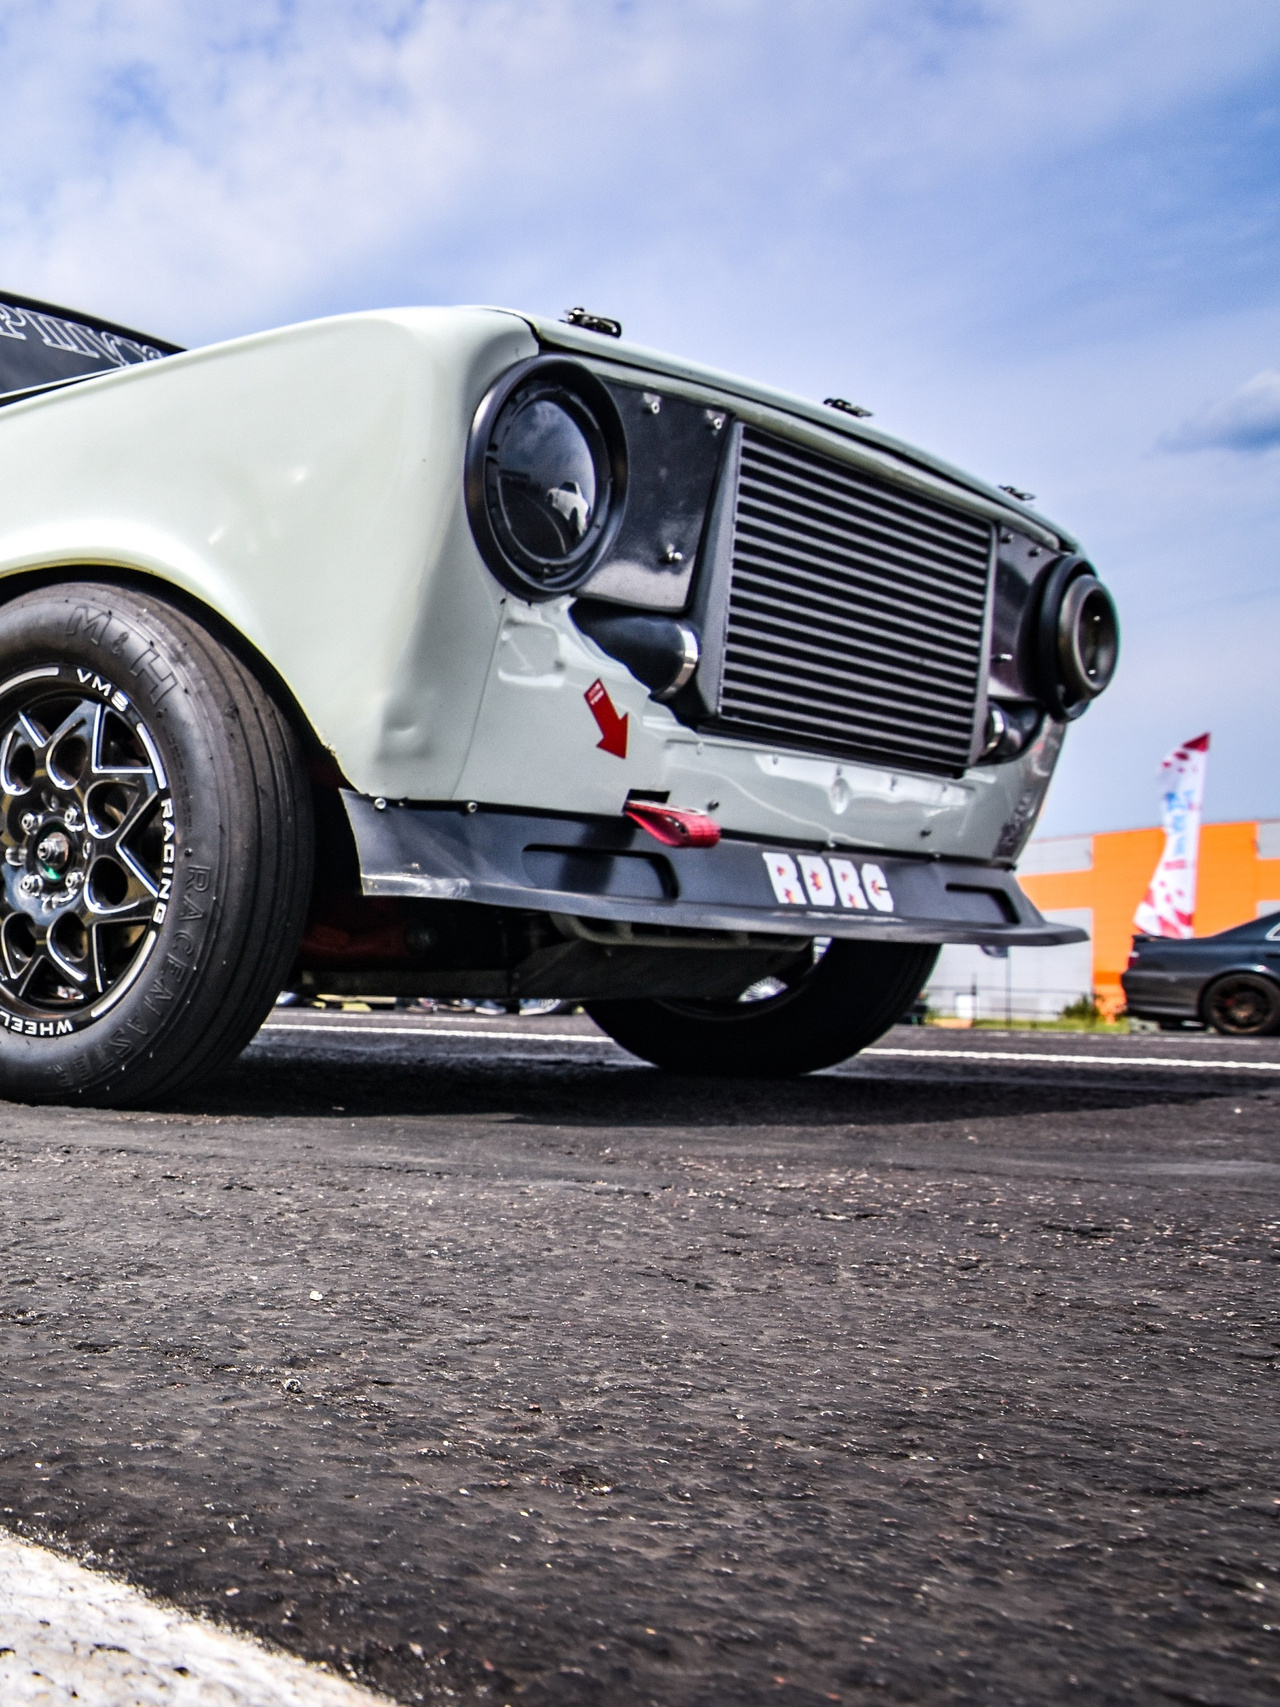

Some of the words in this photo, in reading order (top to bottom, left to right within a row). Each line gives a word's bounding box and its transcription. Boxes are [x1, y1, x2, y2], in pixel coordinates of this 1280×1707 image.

[76, 668, 129, 712] VMS
[153, 799, 175, 924] RACING
[762, 852, 894, 912] RDRC
